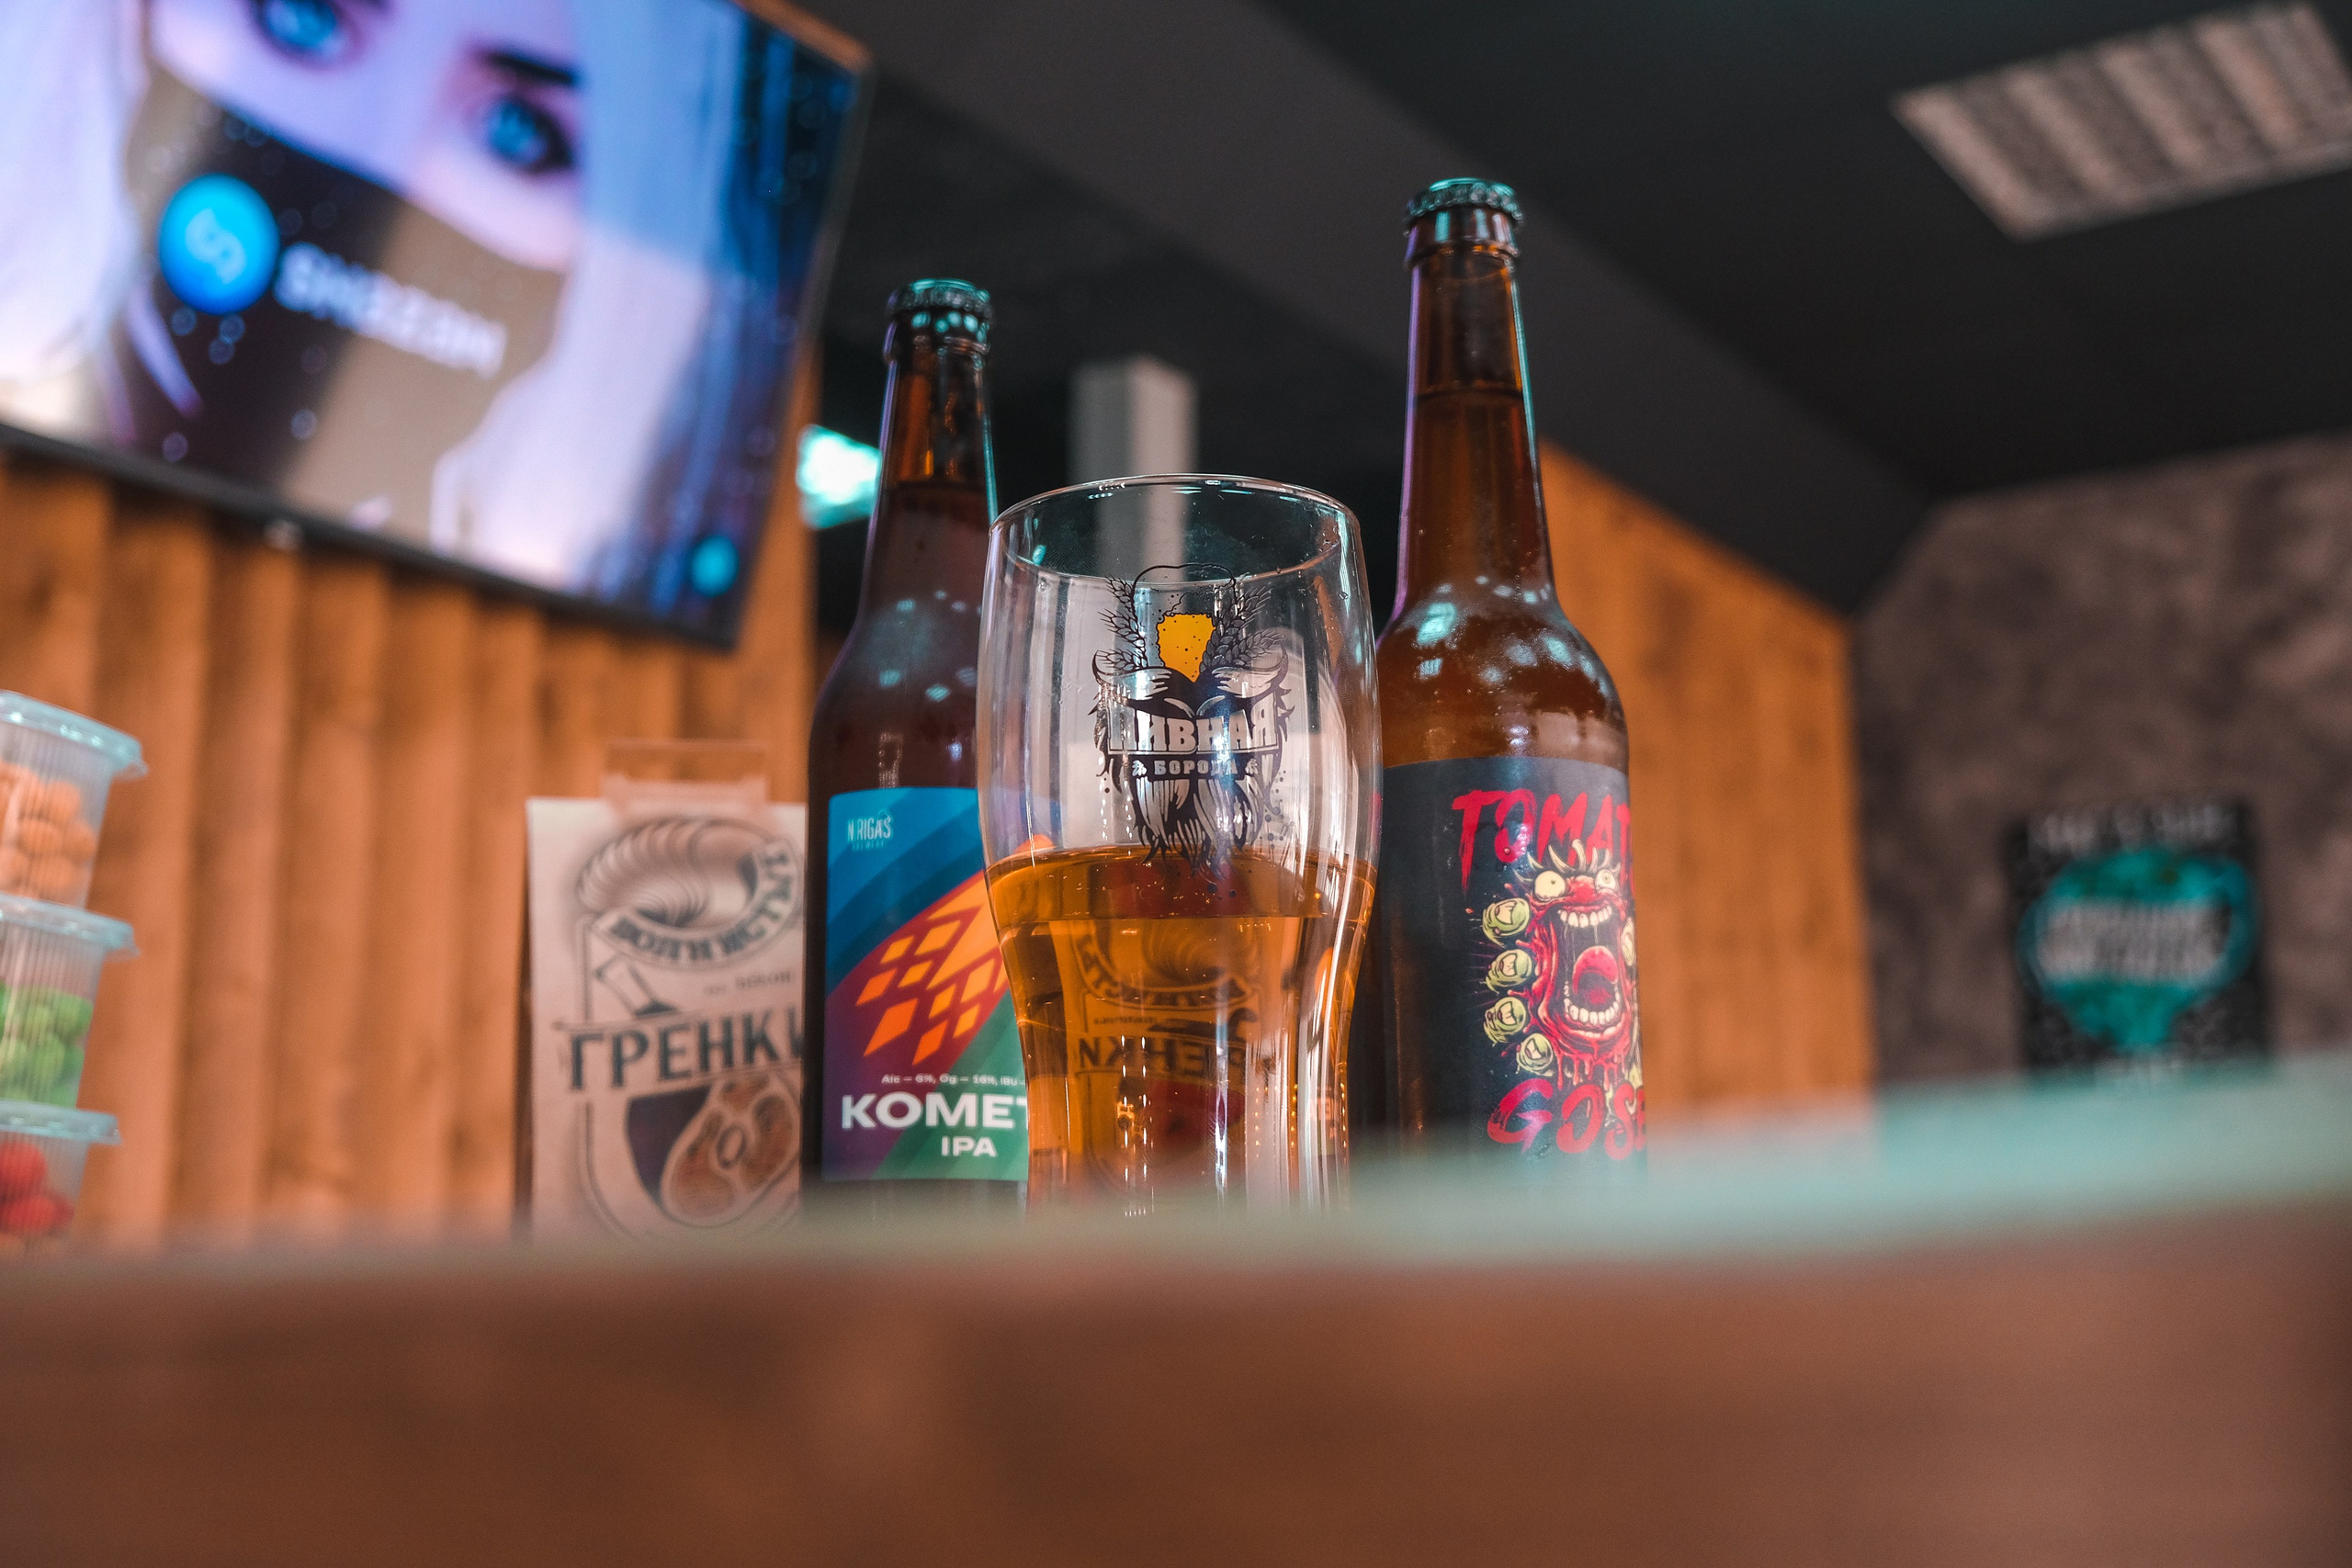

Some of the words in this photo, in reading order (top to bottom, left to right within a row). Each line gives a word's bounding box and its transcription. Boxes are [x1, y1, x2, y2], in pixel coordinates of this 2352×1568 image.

[1109, 693, 1277, 751] ПИВНАЯ
[881, 1073, 900, 1084] Alc
[941, 1135, 997, 1157] IPA
